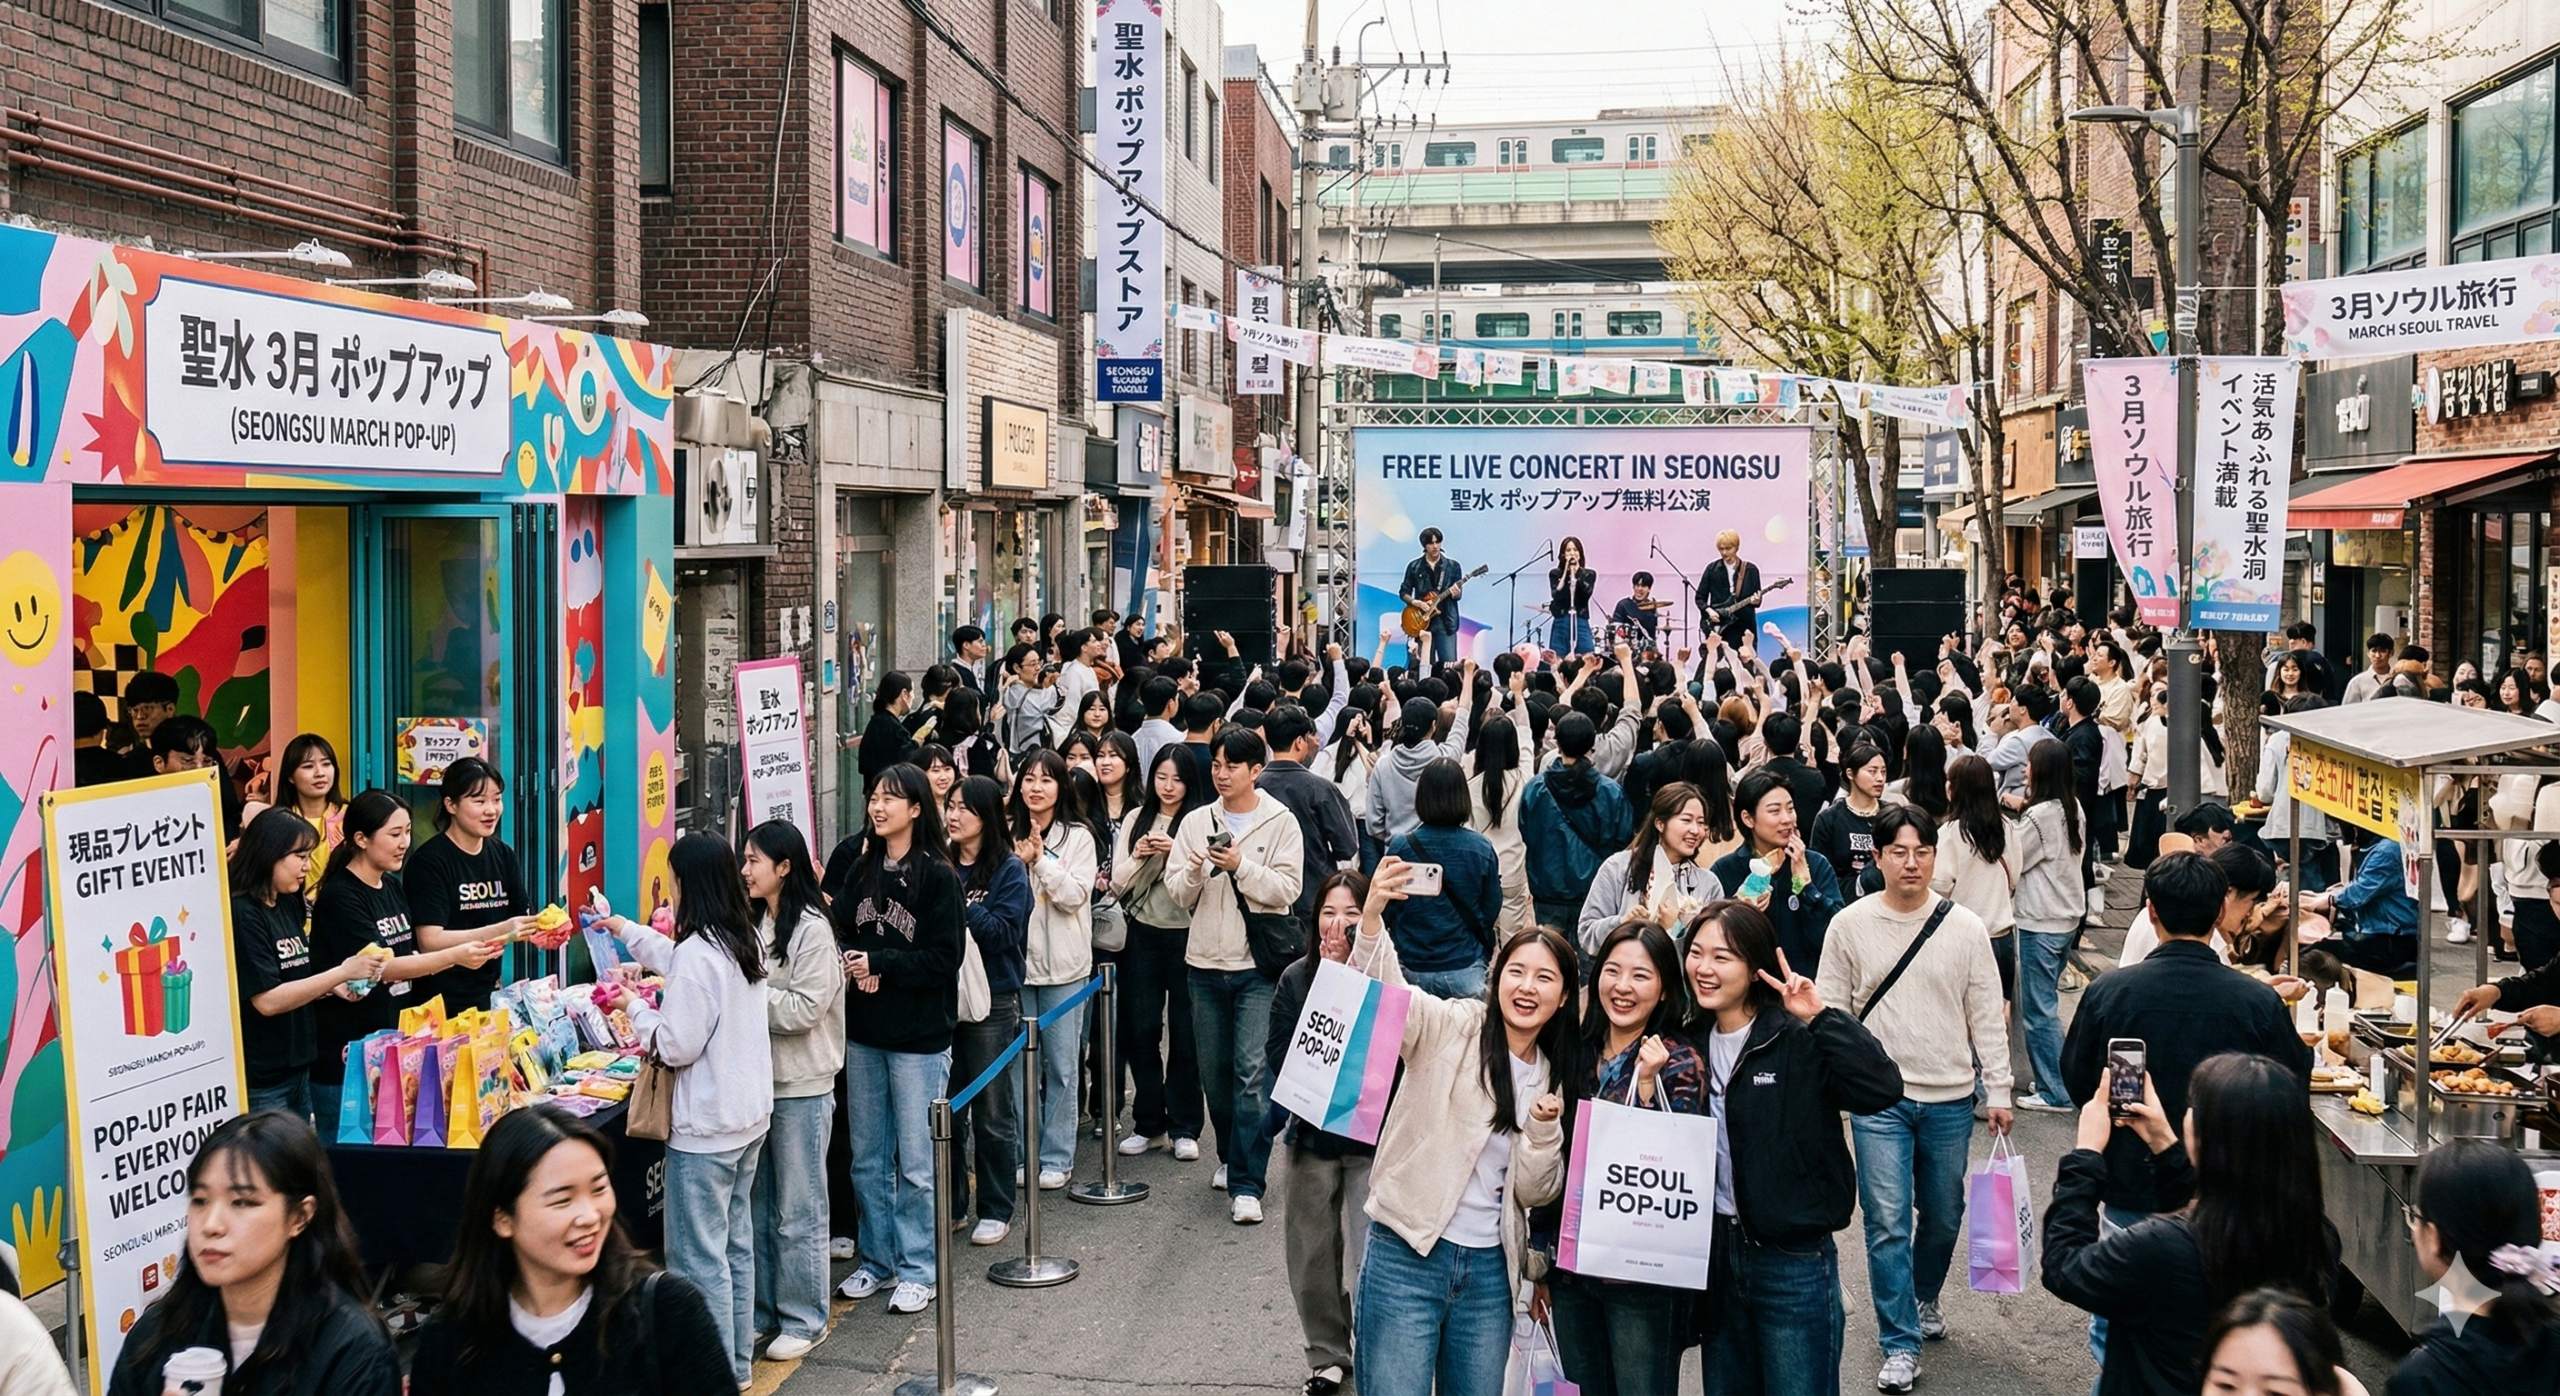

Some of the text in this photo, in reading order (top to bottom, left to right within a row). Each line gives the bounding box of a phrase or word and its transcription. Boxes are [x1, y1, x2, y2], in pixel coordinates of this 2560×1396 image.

[1114, 22, 1146, 332] 聖水 ポップアップストア
[2330, 276, 2517, 321] 3月ソウル旅行
[2348, 313, 2499, 340] MARCH SEOUL TRAVEL
[180, 314, 492, 410] 聖水 3月 ポップアップ
[1105, 366, 1154, 377] SEONGSU
[231, 407, 456, 456] (SEONGSU MARCH POP-UP)
[2214, 373, 2243, 509] イベント満載
[1382, 454, 1780, 480] FREE LIVE CONCERT IN SEONGSU
[2121, 374, 2154, 558] 3月ソウル旅行
[2242, 371, 2277, 581] 活気あふれる聖水洞
[1450, 487, 1711, 512] 聖水 ポップアップ無料公演
[68, 813, 205, 864] 現品プレゼント
[76, 848, 206, 898] GIFT EVENT!
[459, 880, 507, 901] SEOUL
[1296, 1031, 1340, 1067] POP-UP
[1307, 1010, 1346, 1044] SEOUL
[94, 1085, 228, 1153] POP-UP FAIR
[1606, 1163, 1693, 1195] SEOUL
[1599, 1189, 1699, 1221] POP-UP
